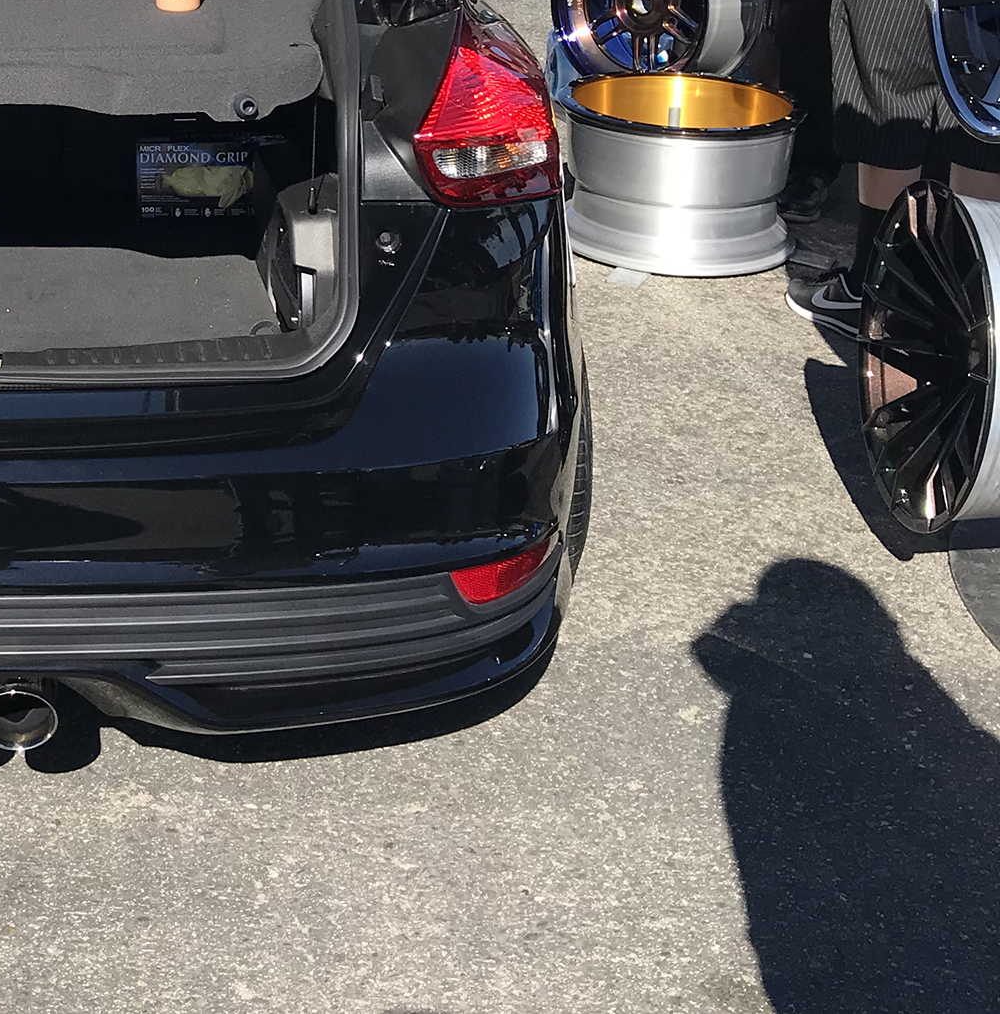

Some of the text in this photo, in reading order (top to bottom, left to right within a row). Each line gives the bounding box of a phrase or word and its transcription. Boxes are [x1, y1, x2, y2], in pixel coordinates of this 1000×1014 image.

[139, 151, 248, 165] DIAMOND GRIP
[140, 206, 155, 214] 100
